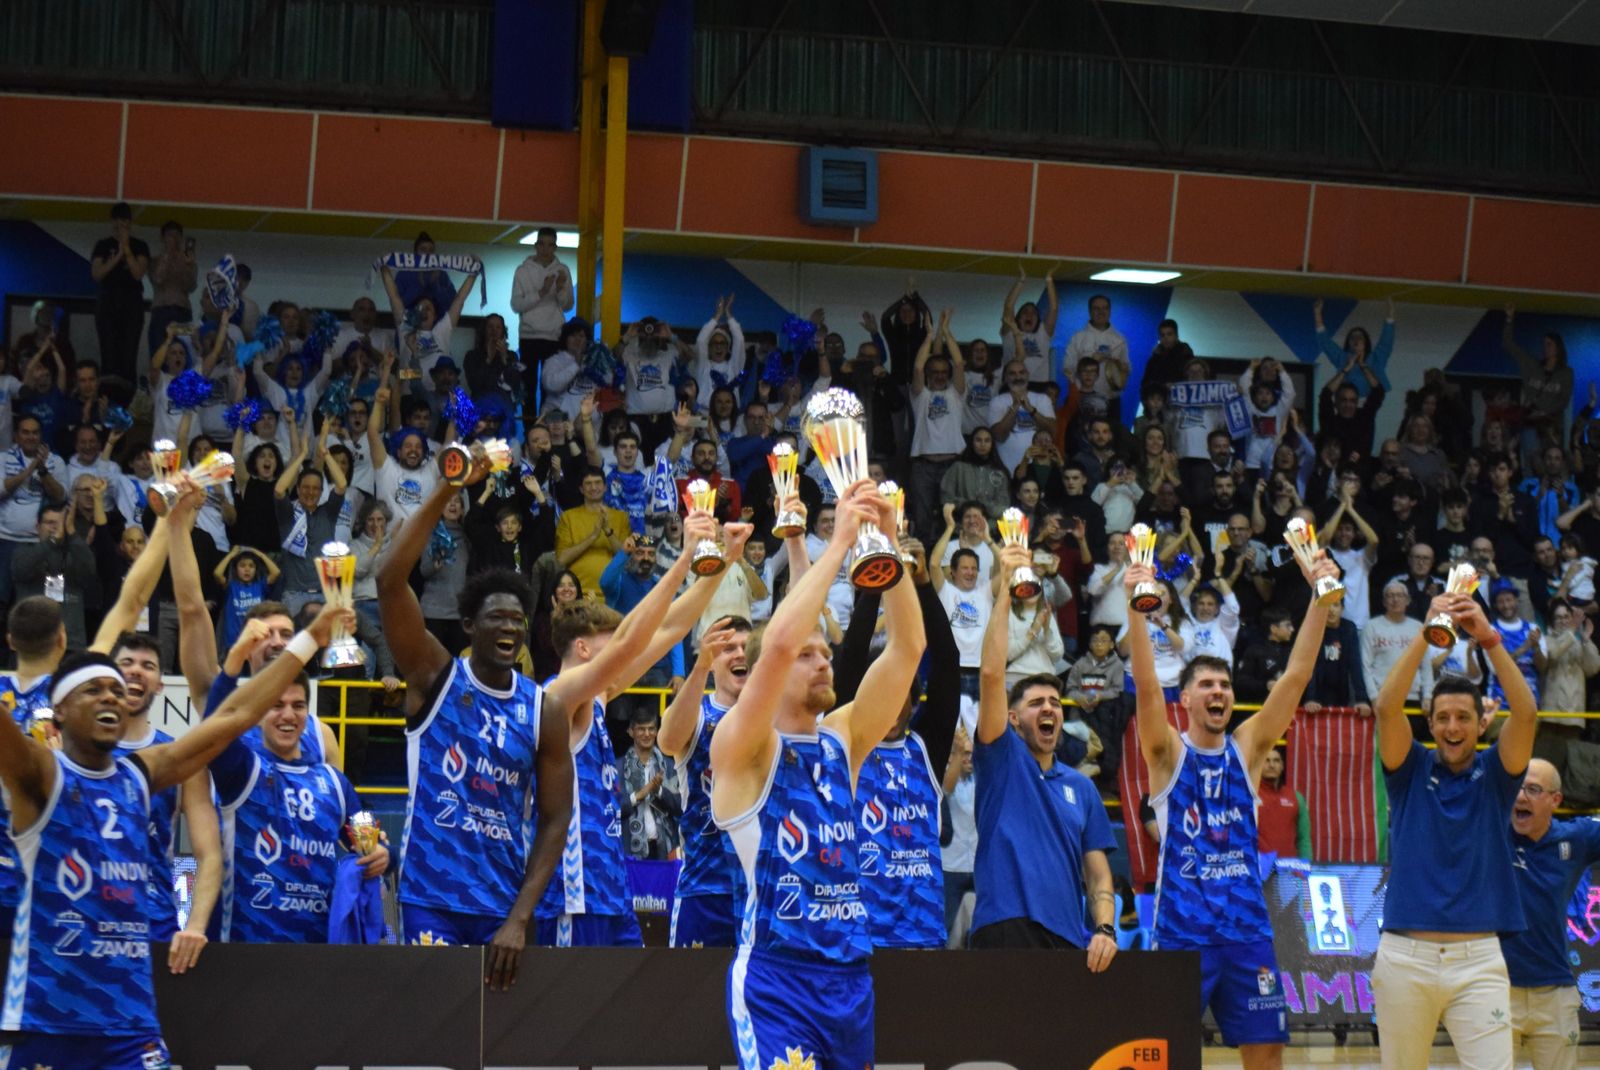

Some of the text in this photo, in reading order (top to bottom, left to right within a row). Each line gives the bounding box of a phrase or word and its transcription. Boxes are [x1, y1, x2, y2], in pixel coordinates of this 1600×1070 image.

[1200, 767, 1224, 799] 17
[95, 798, 124, 839] 2
[91, 940, 150, 959] ZAMOR
[1133, 1048, 1161, 1062] FEB
